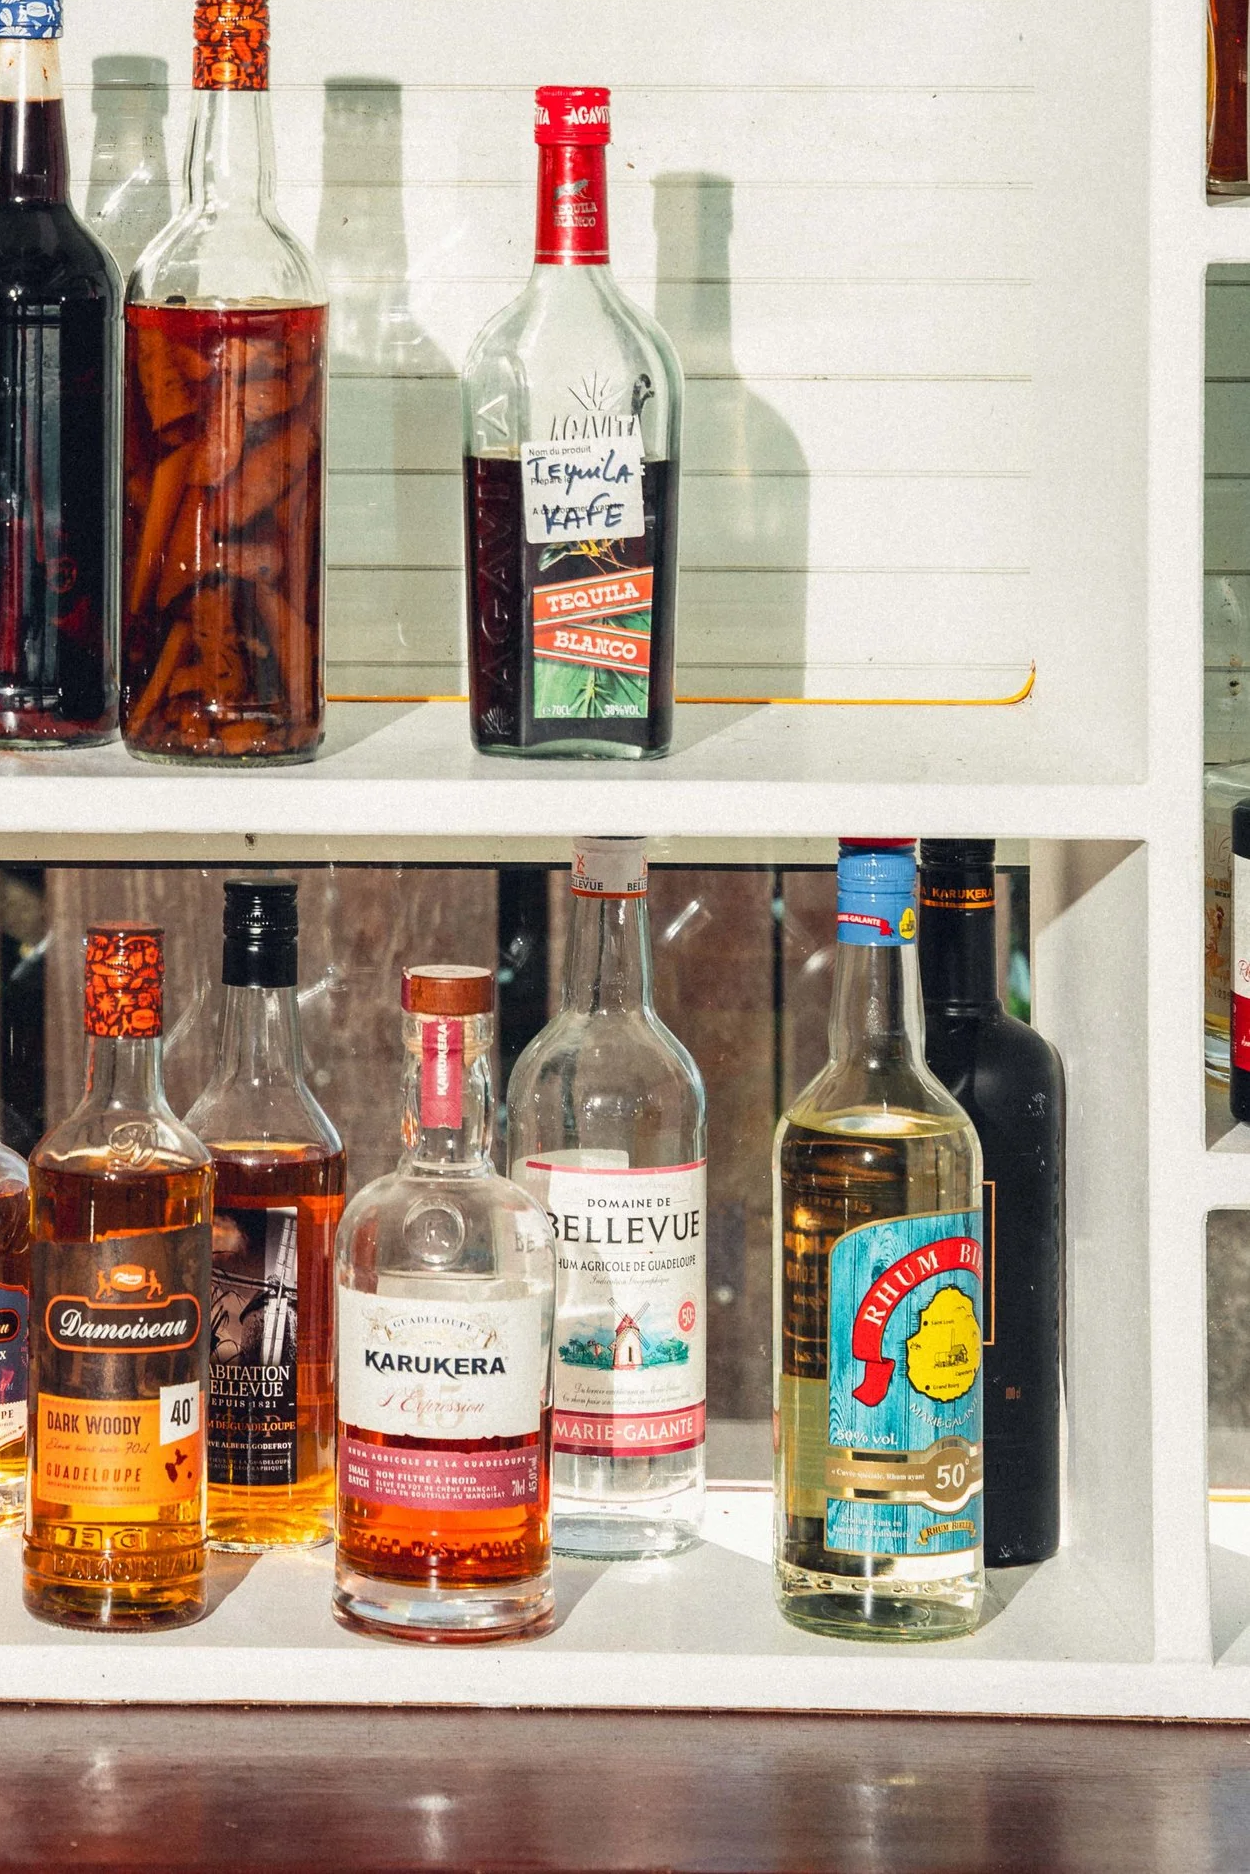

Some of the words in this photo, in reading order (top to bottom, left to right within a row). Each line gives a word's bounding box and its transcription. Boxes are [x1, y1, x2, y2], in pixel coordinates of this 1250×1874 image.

[529, 448, 548, 456] Nom
[550, 447, 560, 455] du
[561, 446, 591, 457] produit
[546, 581, 640, 612] TEQUILA
[553, 630, 638, 660] BLANCO
[932, 887, 993, 901] KARUKERA
[437, 1024, 450, 1096] KARUKERA
[587, 1199, 652, 1208] DOMAINE
[657, 1198, 670, 1207] DE
[546, 1210, 699, 1244] BELLEVUE
[581, 1261, 630, 1272] AGRICOLE
[634, 1261, 645, 1271] DE
[648, 1255, 696, 1271] GUADELOUPE
[864, 1250, 940, 1327] RHUM
[59, 1309, 187, 1339] Damoiseau
[393, 1316, 472, 1332] GUADELOUPE
[365, 1349, 506, 1380] KARUKERA
[210, 1380, 284, 1397] ELLEVUE
[211, 1398, 246, 1408] EPUIS
[251, 1400, 277, 1408] 1821
[47, 1410, 79, 1433] DARK
[85, 1415, 141, 1435] WOODY
[230, 1421, 296, 1432] GUADELOUPE
[554, 1416, 693, 1441] MARIE-GALANTE
[221, 1441, 249, 1450] ALBERT
[251, 1441, 292, 1450] GODEFROY
[372, 1453, 420, 1467] AGRICOLE
[426, 1459, 439, 1467] DE
[445, 1459, 457, 1468] LA
[464, 1456, 526, 1468] GUADELOUPE
[46, 1463, 142, 1483] GUADELOUPE
[348, 1464, 369, 1478] SMALL
[376, 1470, 395, 1481] NON
[445, 1476, 476, 1485] FROID
[348, 1474, 370, 1488] BATCH
[411, 1491, 449, 1499] BOUTEILLE
[466, 1491, 505, 1500] MARQUISAT
[926, 1524, 949, 1536] RHUM
